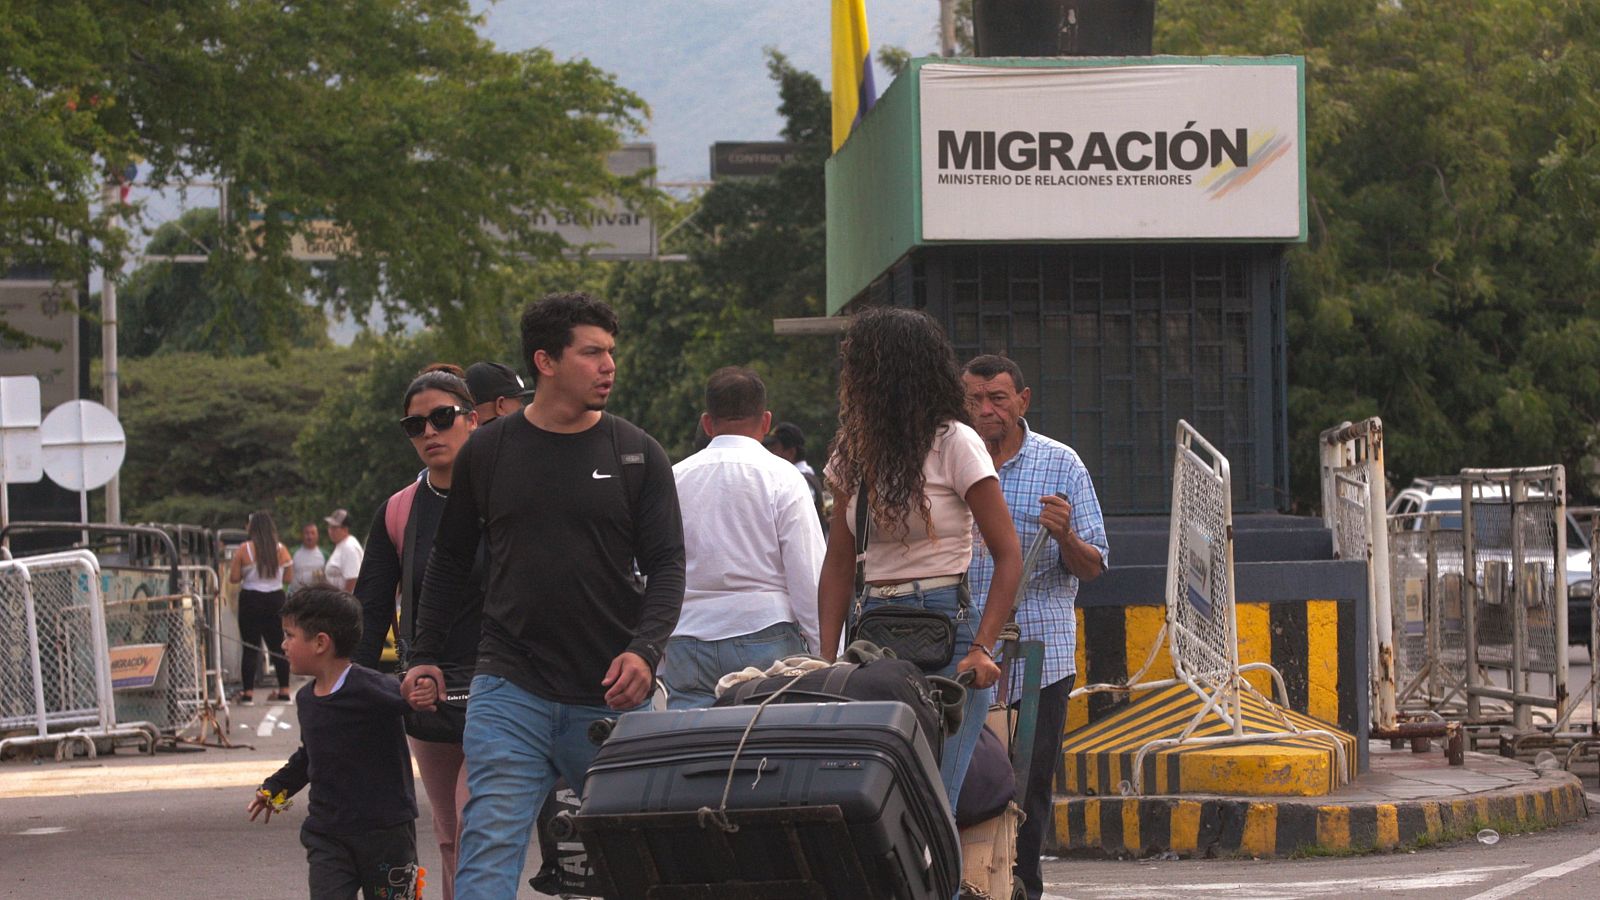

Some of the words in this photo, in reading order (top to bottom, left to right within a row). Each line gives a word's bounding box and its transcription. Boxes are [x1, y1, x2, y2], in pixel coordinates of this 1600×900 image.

[938, 120, 1248, 171] MIGRACIÓN
[938, 174, 1012, 185] MINISTERIO
[1015, 175, 1032, 185] DE
[1035, 175, 1113, 186] RELACIONES
[1116, 174, 1192, 186] EXTERIORES
